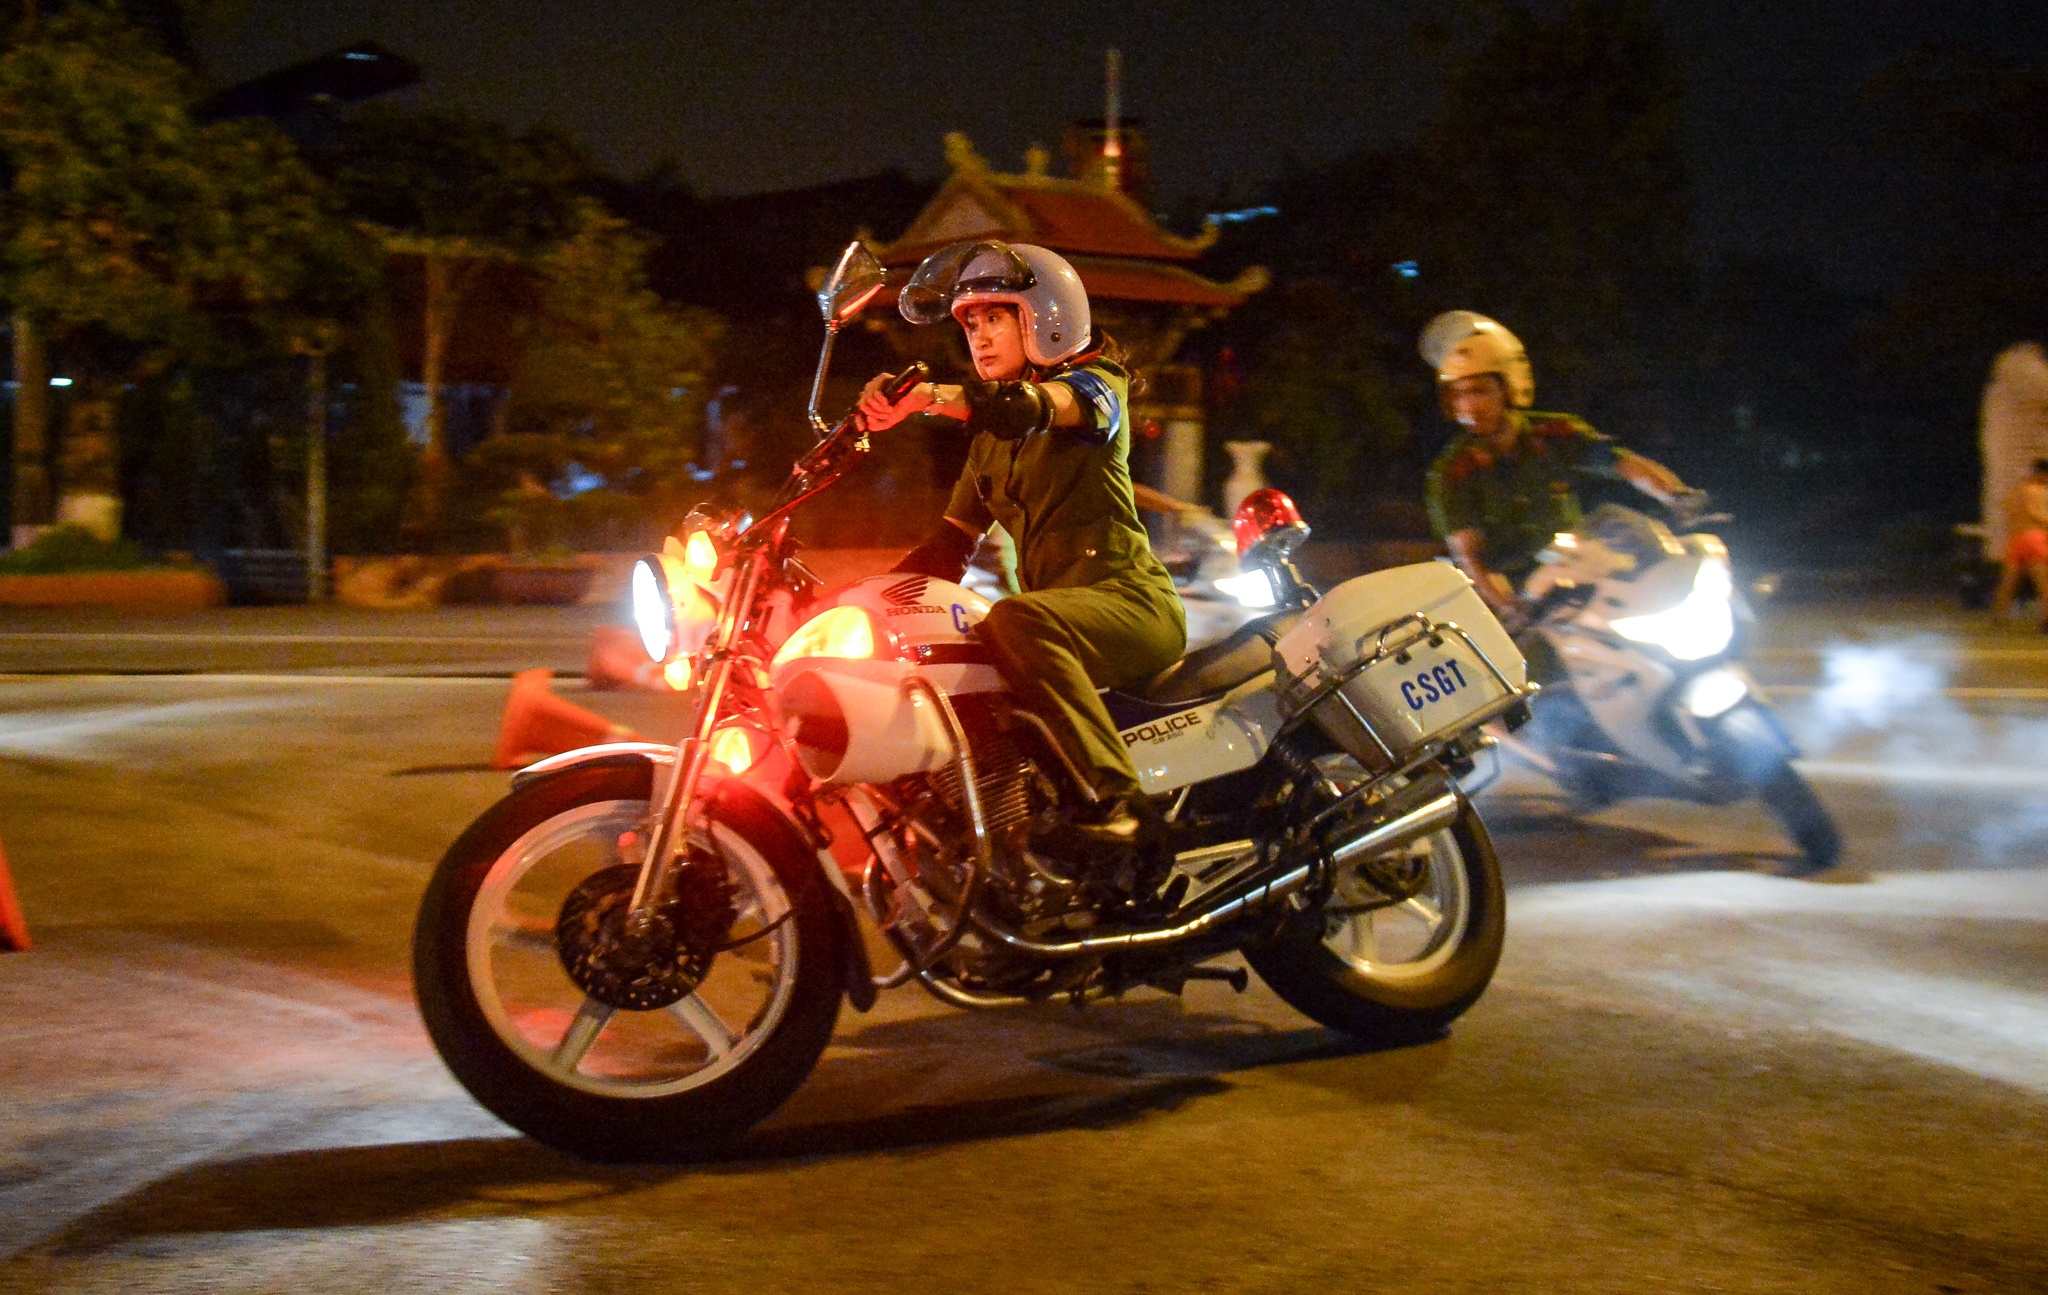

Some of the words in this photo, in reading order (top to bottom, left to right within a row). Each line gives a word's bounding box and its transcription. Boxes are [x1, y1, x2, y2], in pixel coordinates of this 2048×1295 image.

[886, 605, 947, 617] HONDA
[1401, 659, 1467, 711] CSGT
[1122, 711, 1202, 748] POLICE
